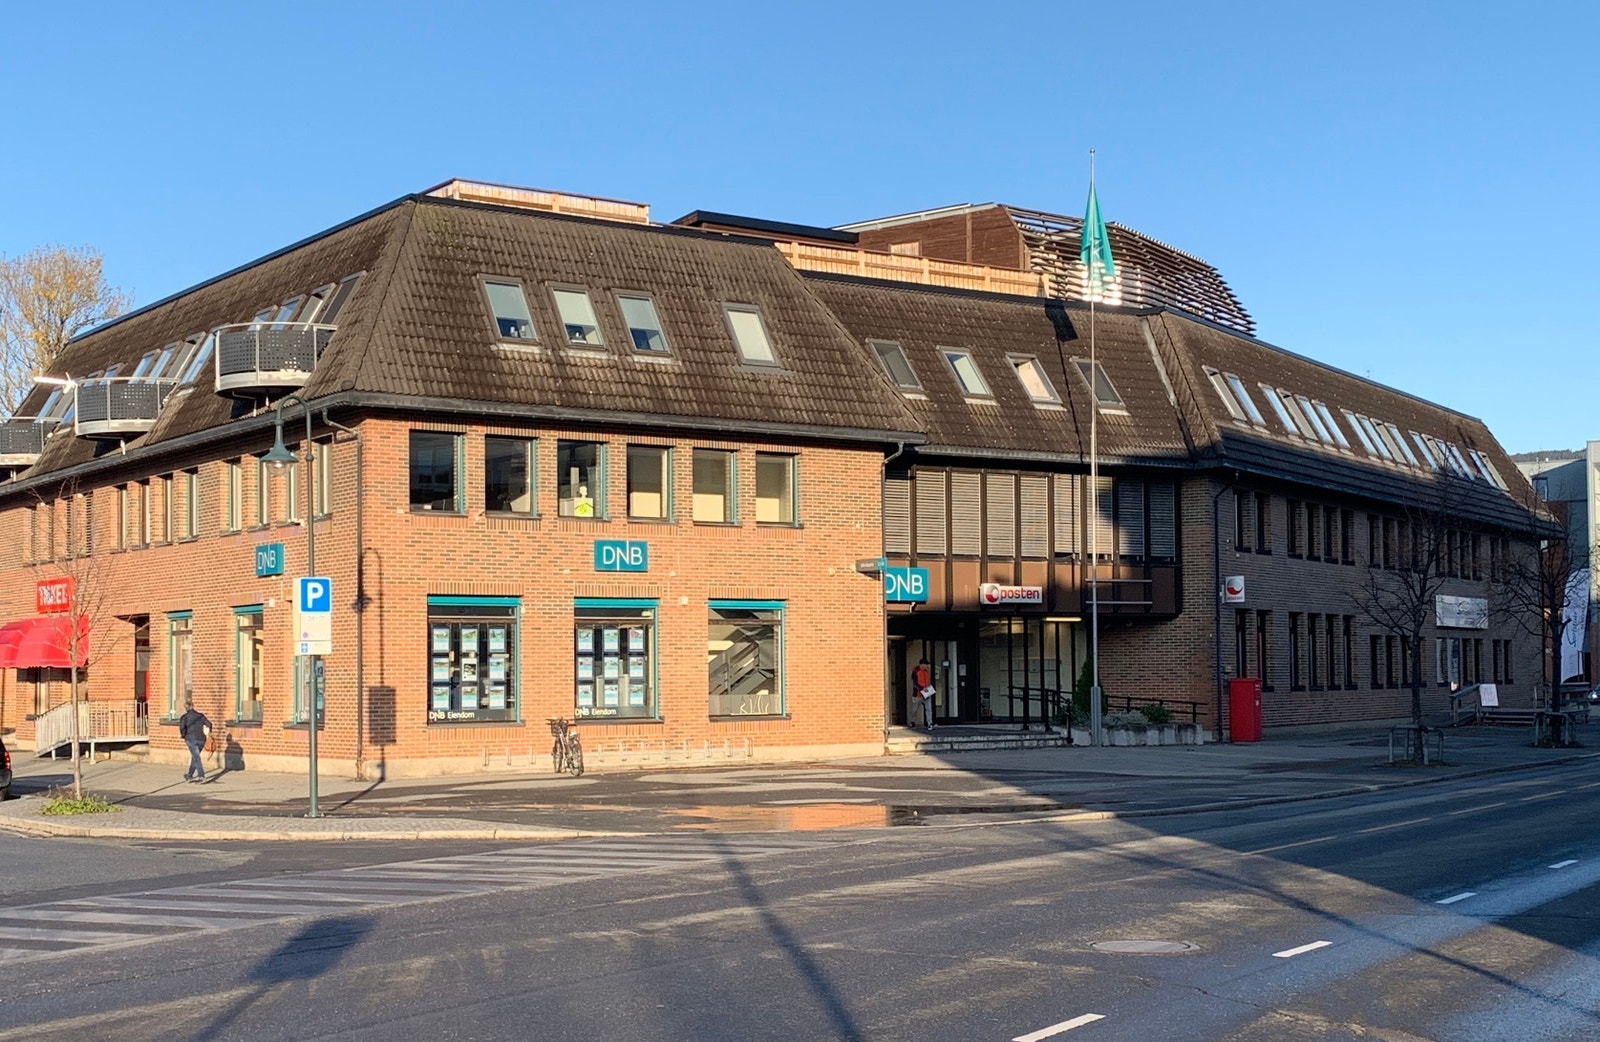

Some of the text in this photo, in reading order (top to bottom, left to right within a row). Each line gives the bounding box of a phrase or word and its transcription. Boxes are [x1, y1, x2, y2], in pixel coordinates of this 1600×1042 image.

[257, 544, 276, 575] DNB
[602, 540, 643, 571] DNB
[307, 582, 324, 609] P
[885, 567, 924, 601] DNB
[1000, 587, 1040, 601] posten
[429, 709, 475, 721] DNB Eiendom
[575, 706, 590, 718] DNB
